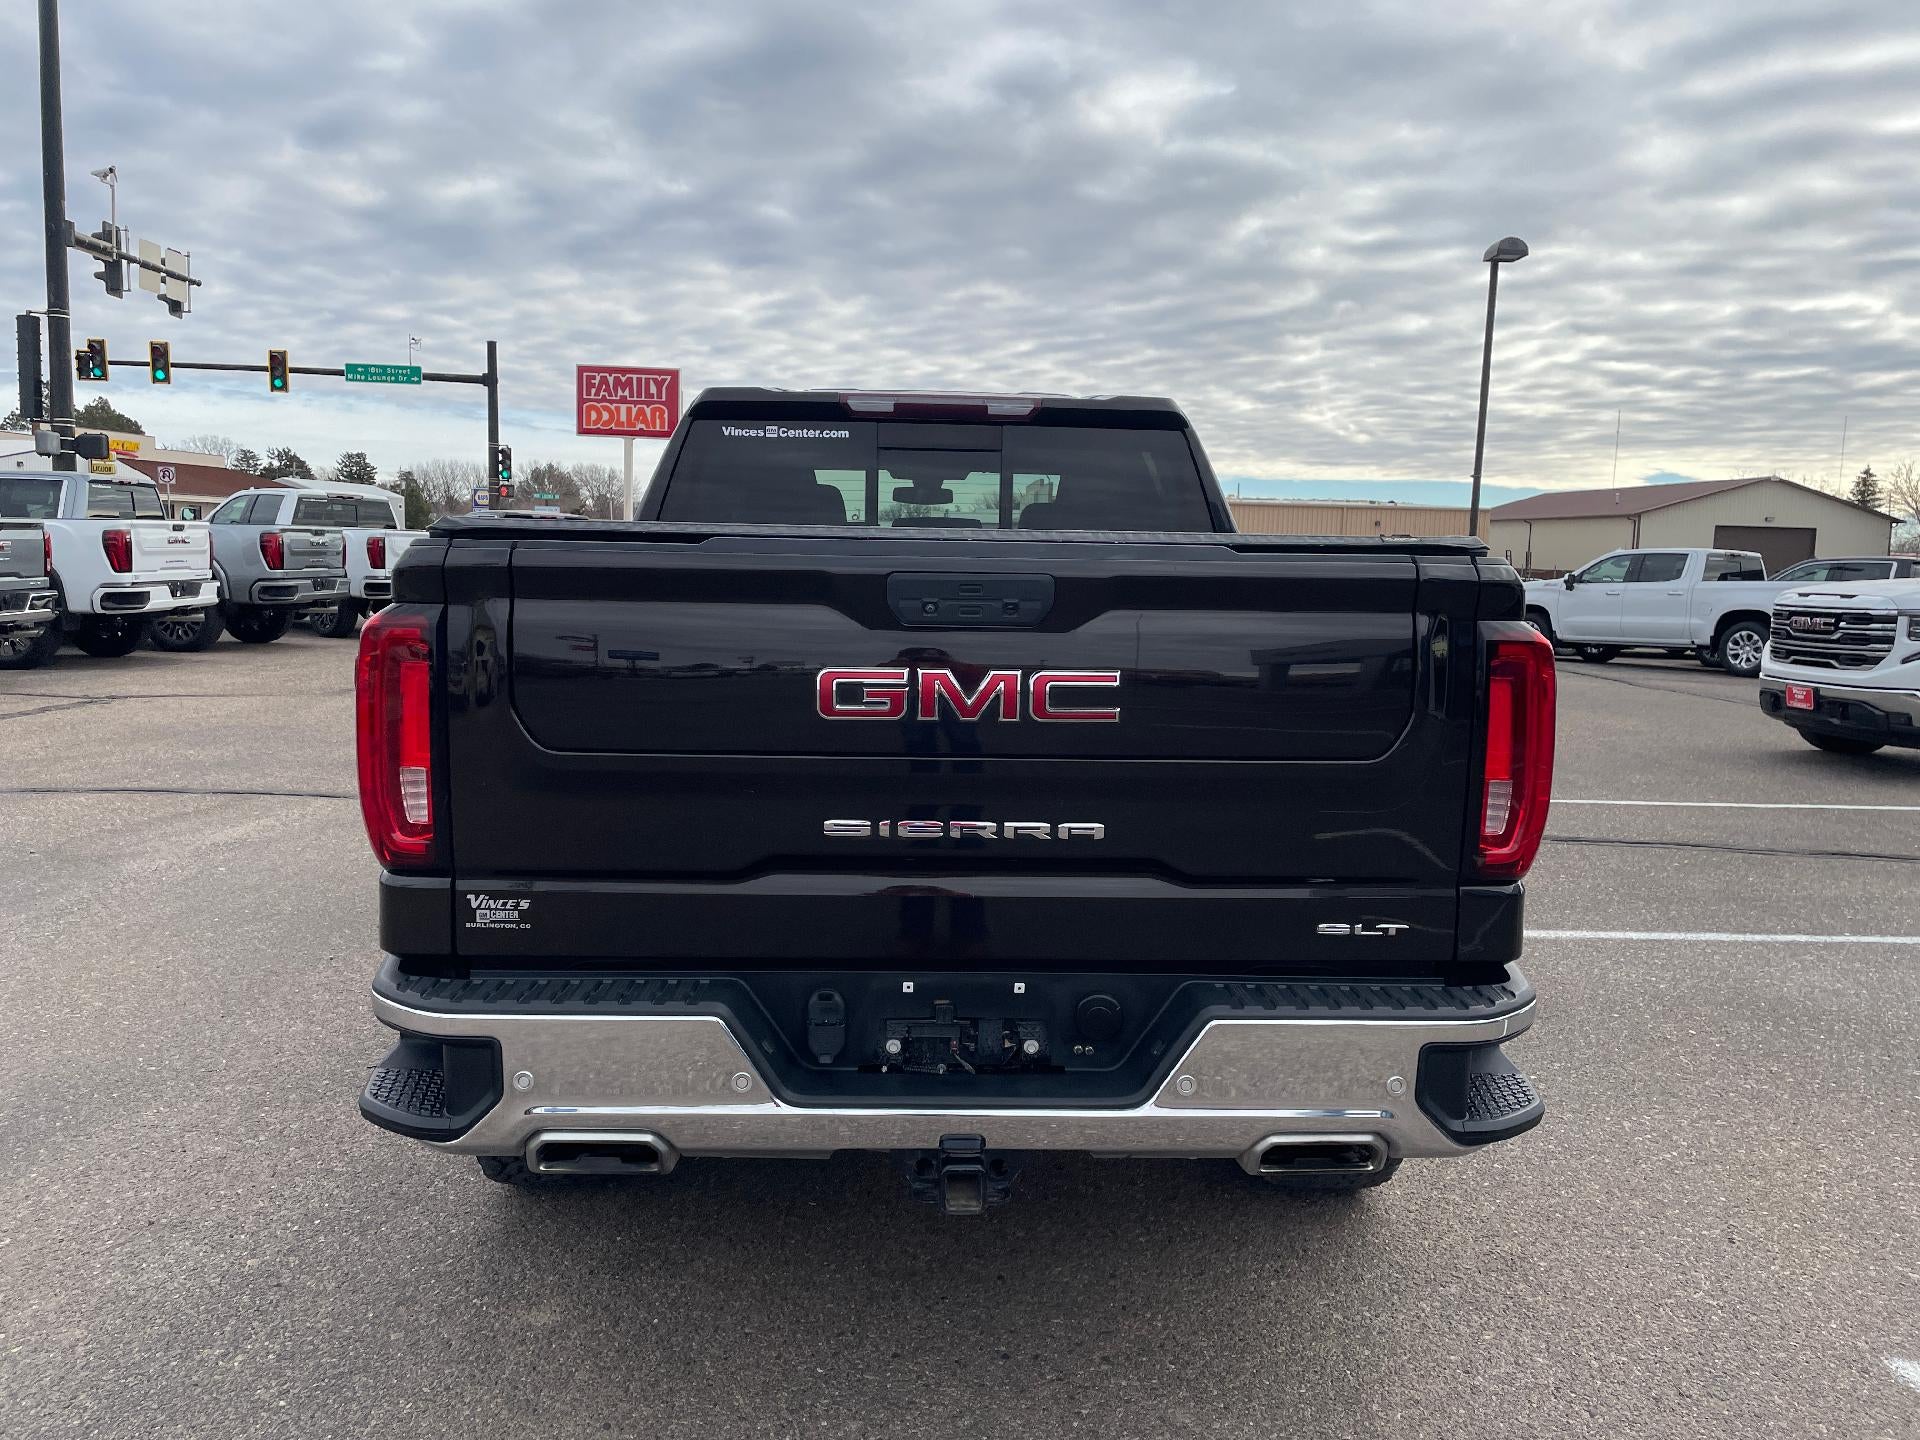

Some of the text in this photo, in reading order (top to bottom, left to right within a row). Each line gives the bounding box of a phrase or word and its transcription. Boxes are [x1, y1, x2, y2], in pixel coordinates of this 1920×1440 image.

[386, 367, 411, 375] Street
[367, 374, 396, 383] Lounge
[583, 372, 672, 401] FAMILY
[583, 402, 668, 431] DOLLAR
[722, 426, 765, 437] Vinces
[779, 427, 850, 438] Center.com
[1790, 616, 1835, 630] GMC
[816, 667, 1121, 722] GMC
[823, 819, 1106, 840] SIERRA
[490, 911, 519, 919] CENTER
[1317, 923, 1410, 936] SLT
